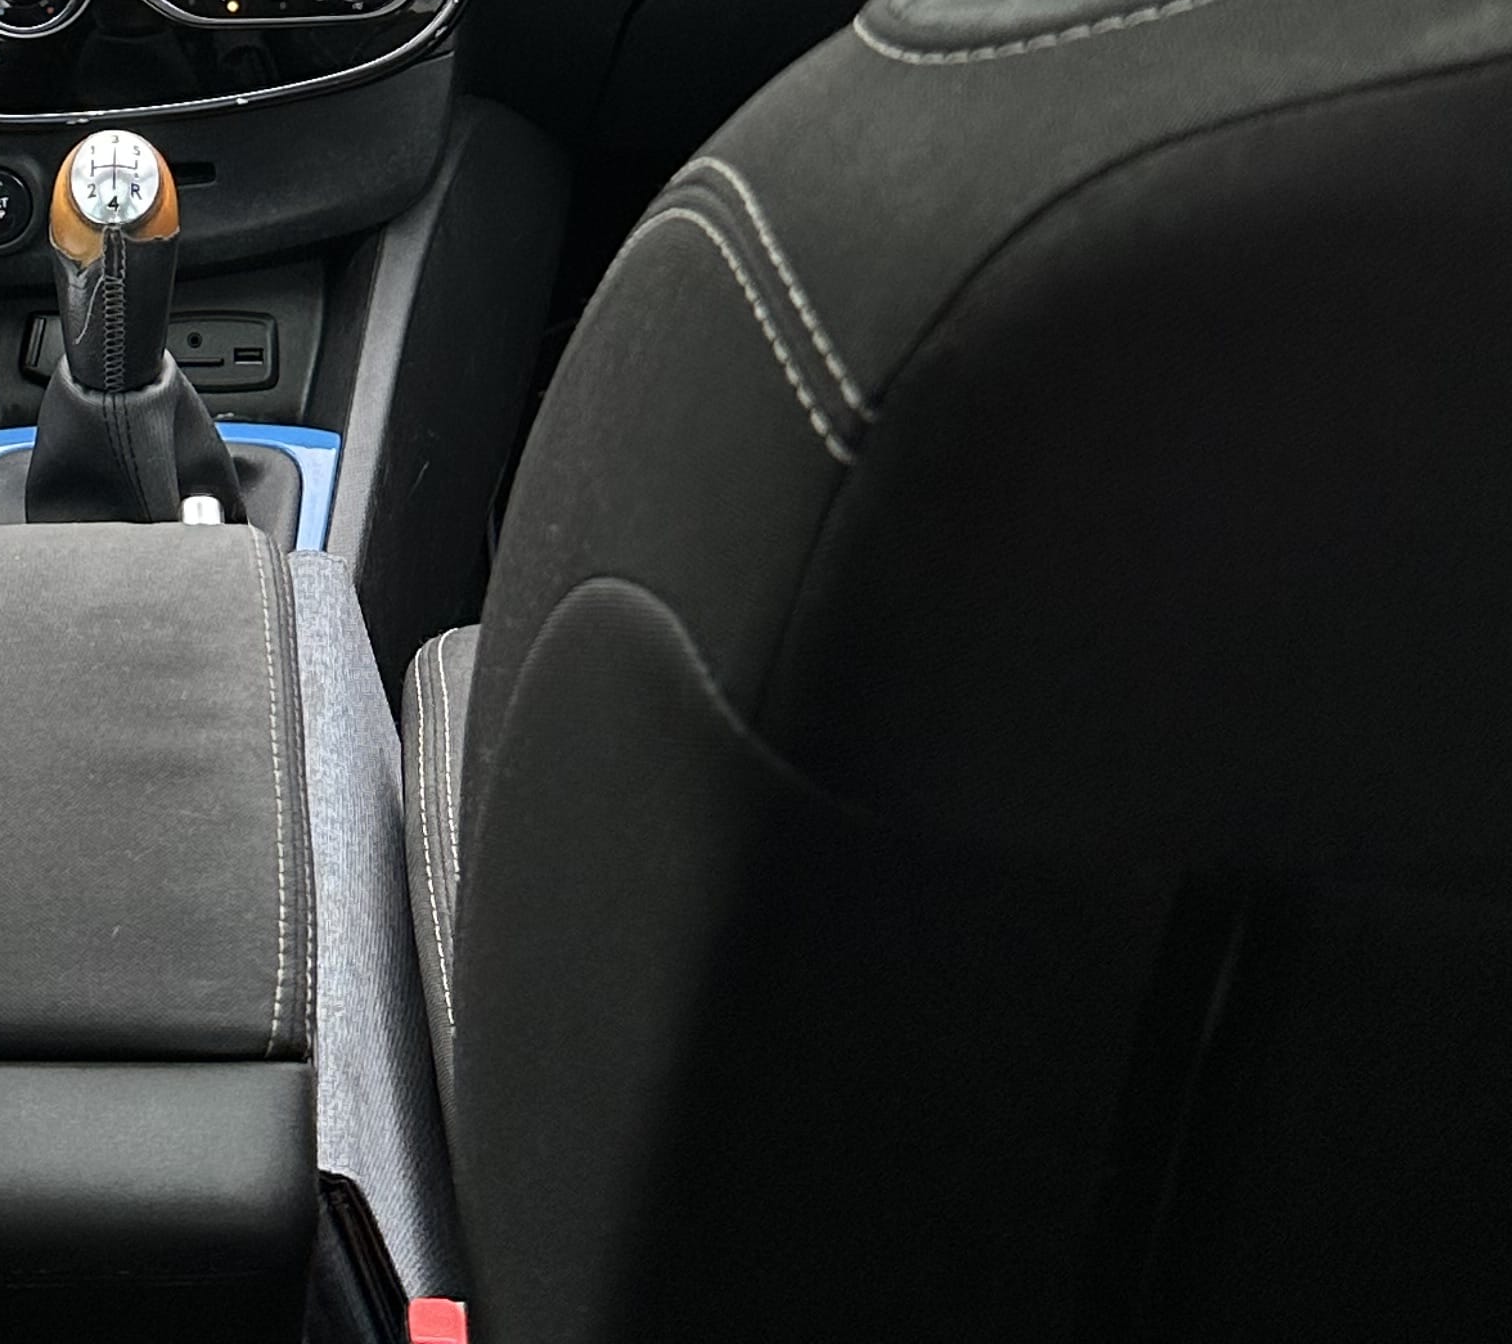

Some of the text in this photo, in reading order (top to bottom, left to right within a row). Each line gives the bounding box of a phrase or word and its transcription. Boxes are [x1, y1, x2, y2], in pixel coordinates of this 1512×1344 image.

[111, 135, 119, 143] 3
[133, 145, 140, 156] 5
[87, 184, 97, 198] 2
[130, 184, 142, 200] R
[107, 195, 119, 212] 4
